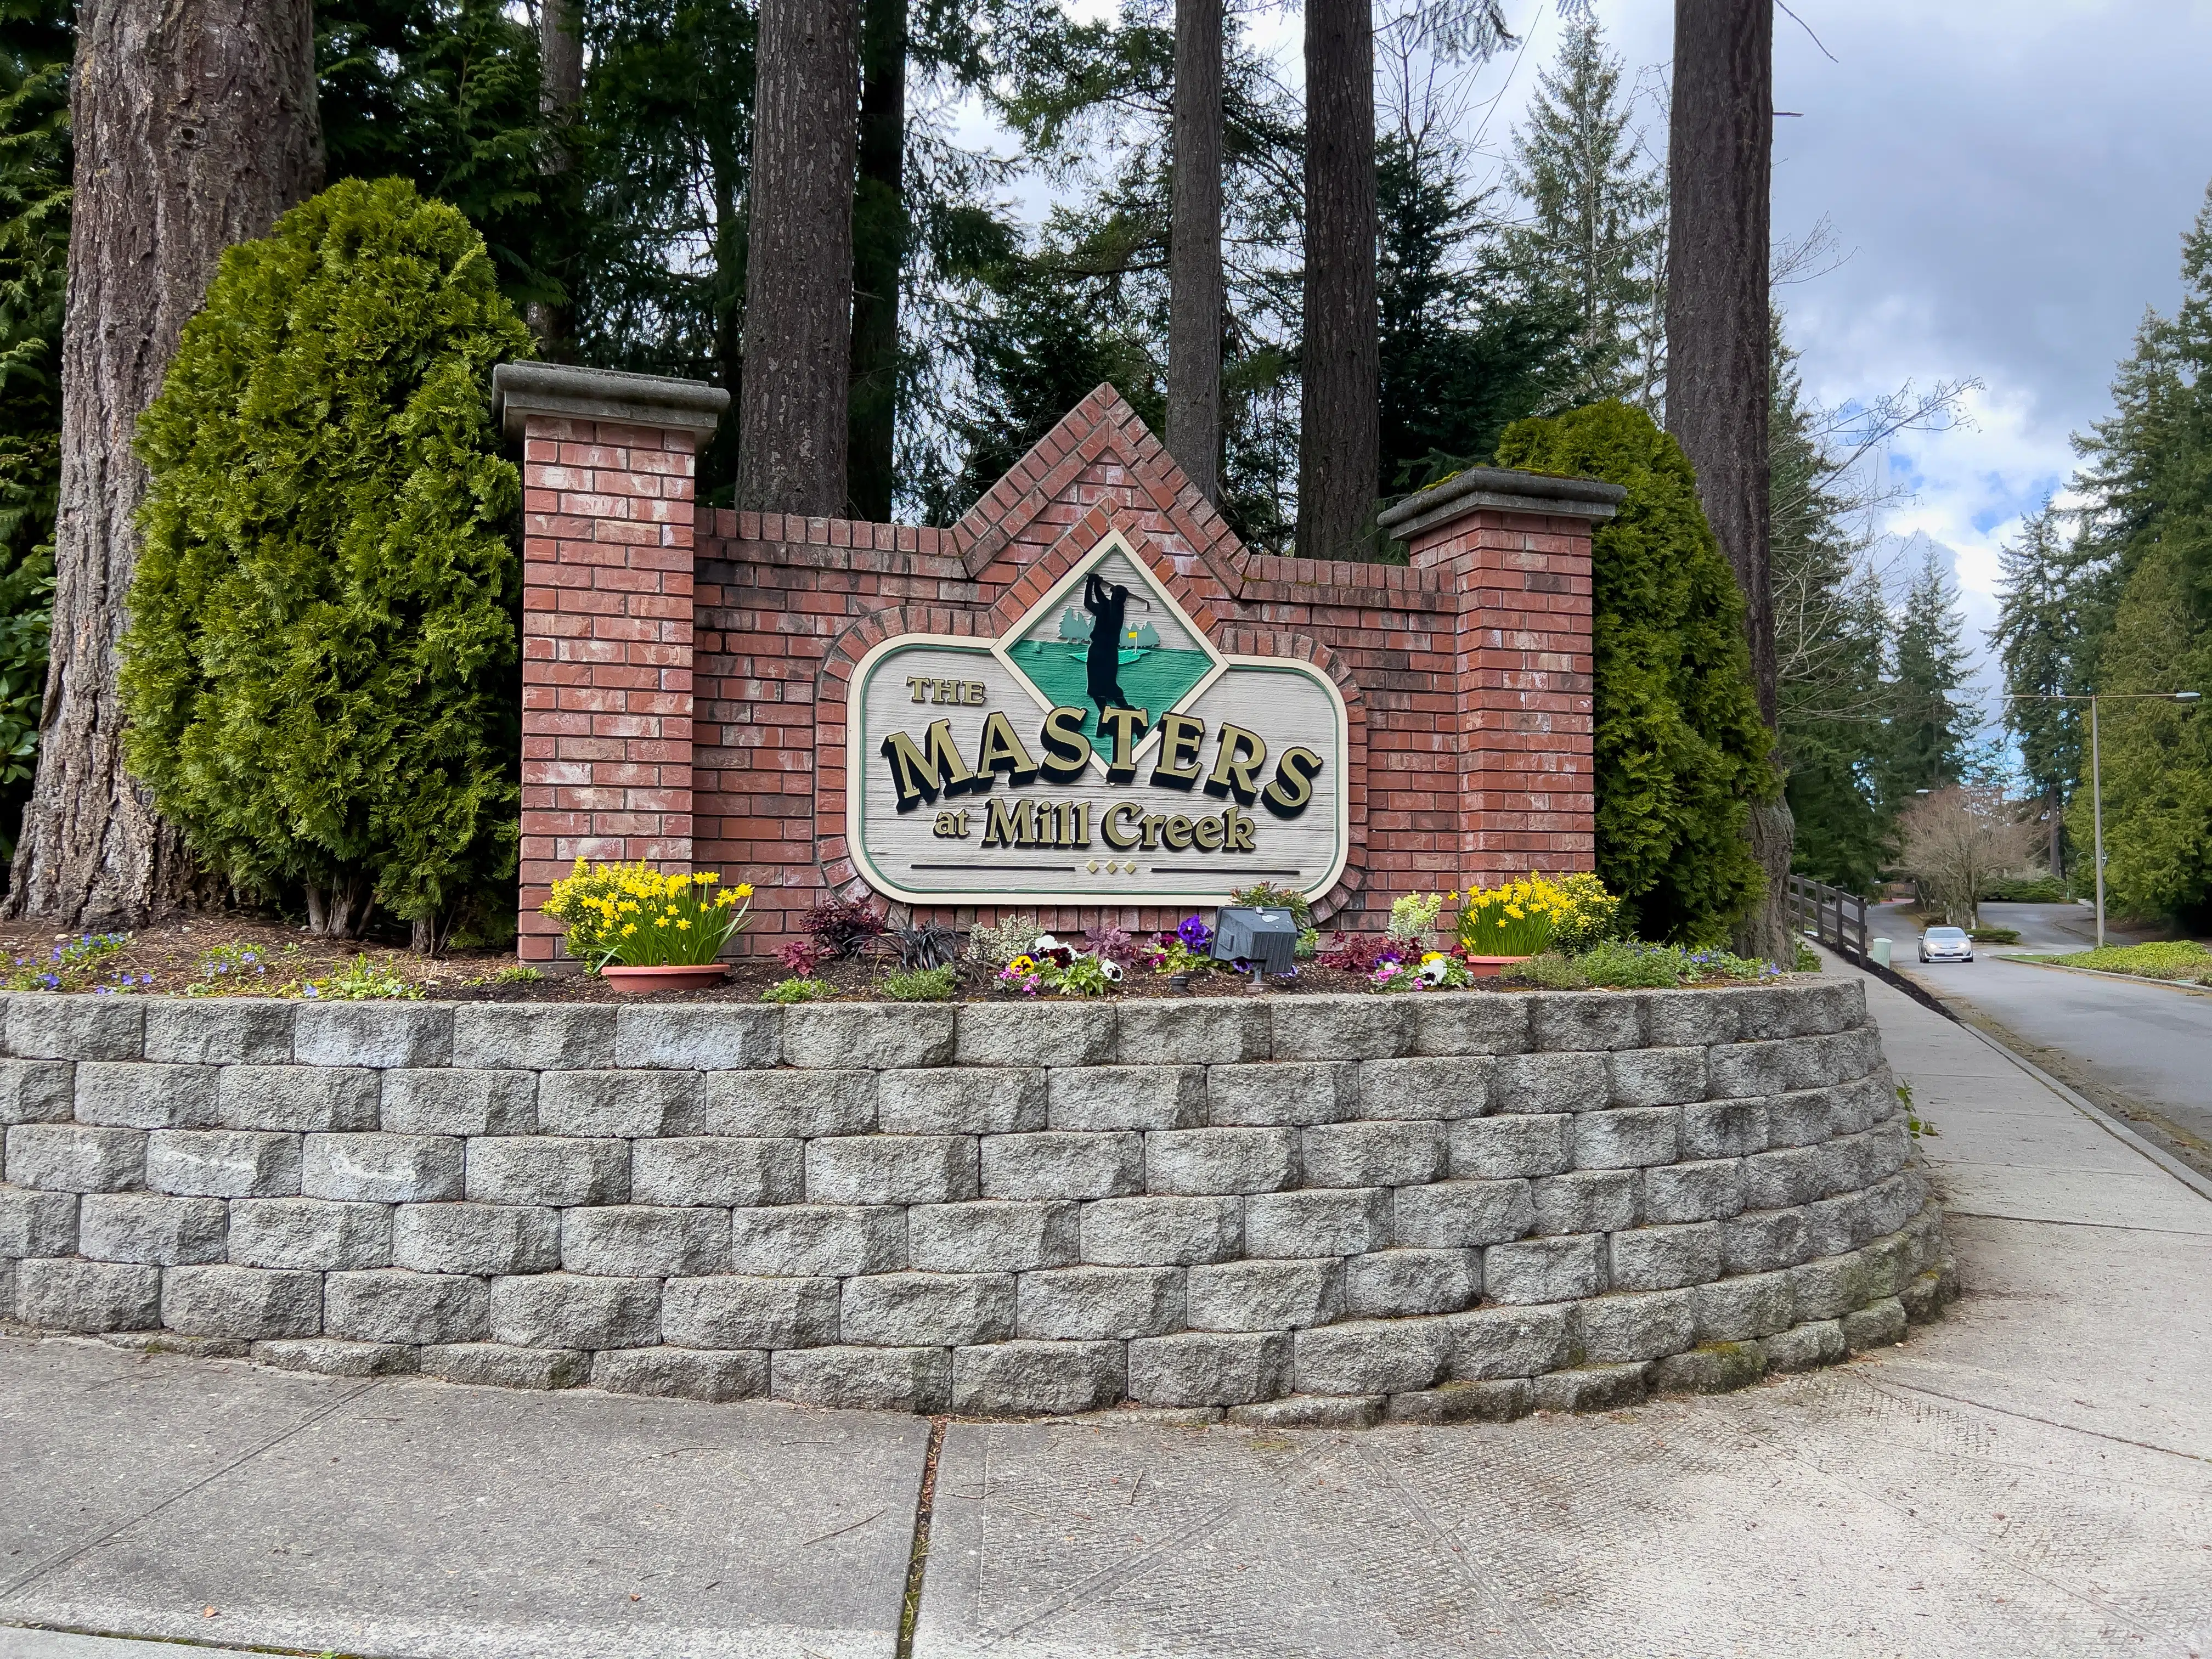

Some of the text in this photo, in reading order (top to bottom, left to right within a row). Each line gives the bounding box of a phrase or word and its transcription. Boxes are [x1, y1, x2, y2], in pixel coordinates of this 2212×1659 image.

[906, 676, 987, 706] THE
[881, 706, 1323, 819] MASTERS
[933, 798, 1256, 853] at Mill Creek
